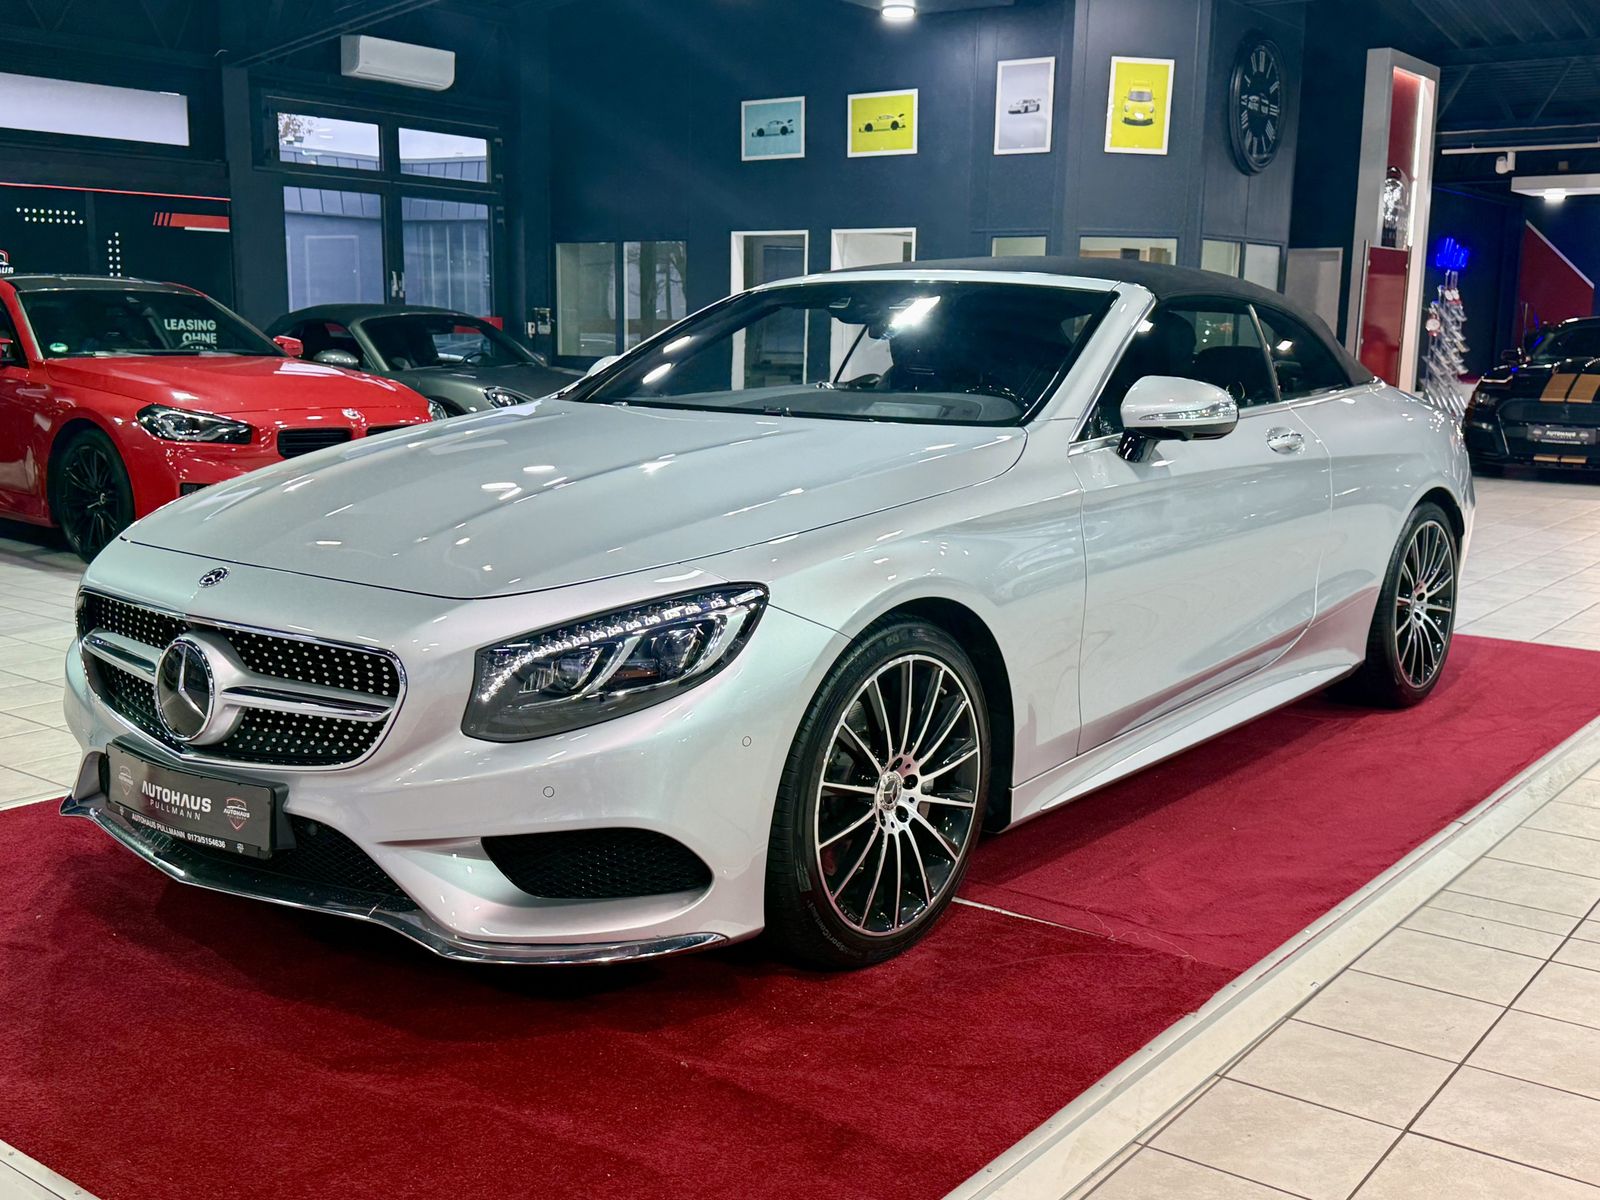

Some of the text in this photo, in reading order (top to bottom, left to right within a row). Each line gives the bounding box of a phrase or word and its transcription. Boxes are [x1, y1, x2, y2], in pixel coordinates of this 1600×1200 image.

[164, 318, 217, 331] LEASING
[182, 332, 218, 344] OHNE
[142, 780, 212, 813] AUTOHAUS
[150, 798, 201, 821] PULLMANN
[132, 813, 157, 829] AUTOHAUS
[156, 823, 186, 839] PULLMANN
